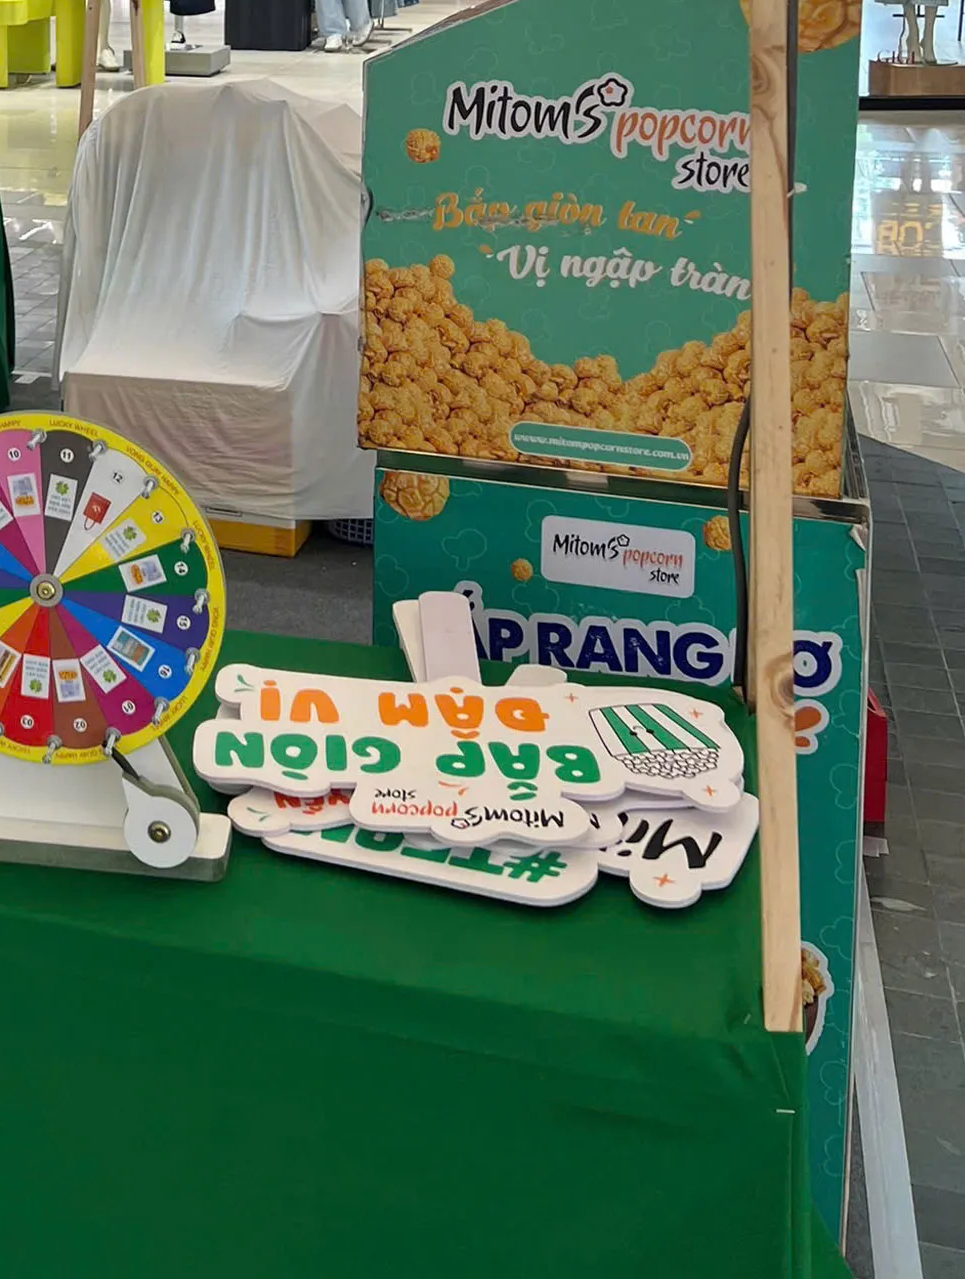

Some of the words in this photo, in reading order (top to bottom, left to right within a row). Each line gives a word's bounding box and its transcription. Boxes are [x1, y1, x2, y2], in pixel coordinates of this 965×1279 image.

[680, 152, 750, 188] store
[560, 247, 662, 289] ngập
[9, 449, 20, 459] 10
[62, 450, 72, 461] 11
[623, 548, 683, 570] popcorn
[650, 568, 680, 586] store
[537, 621, 724, 680] RANG
[793, 641, 833, 689] Ơ
